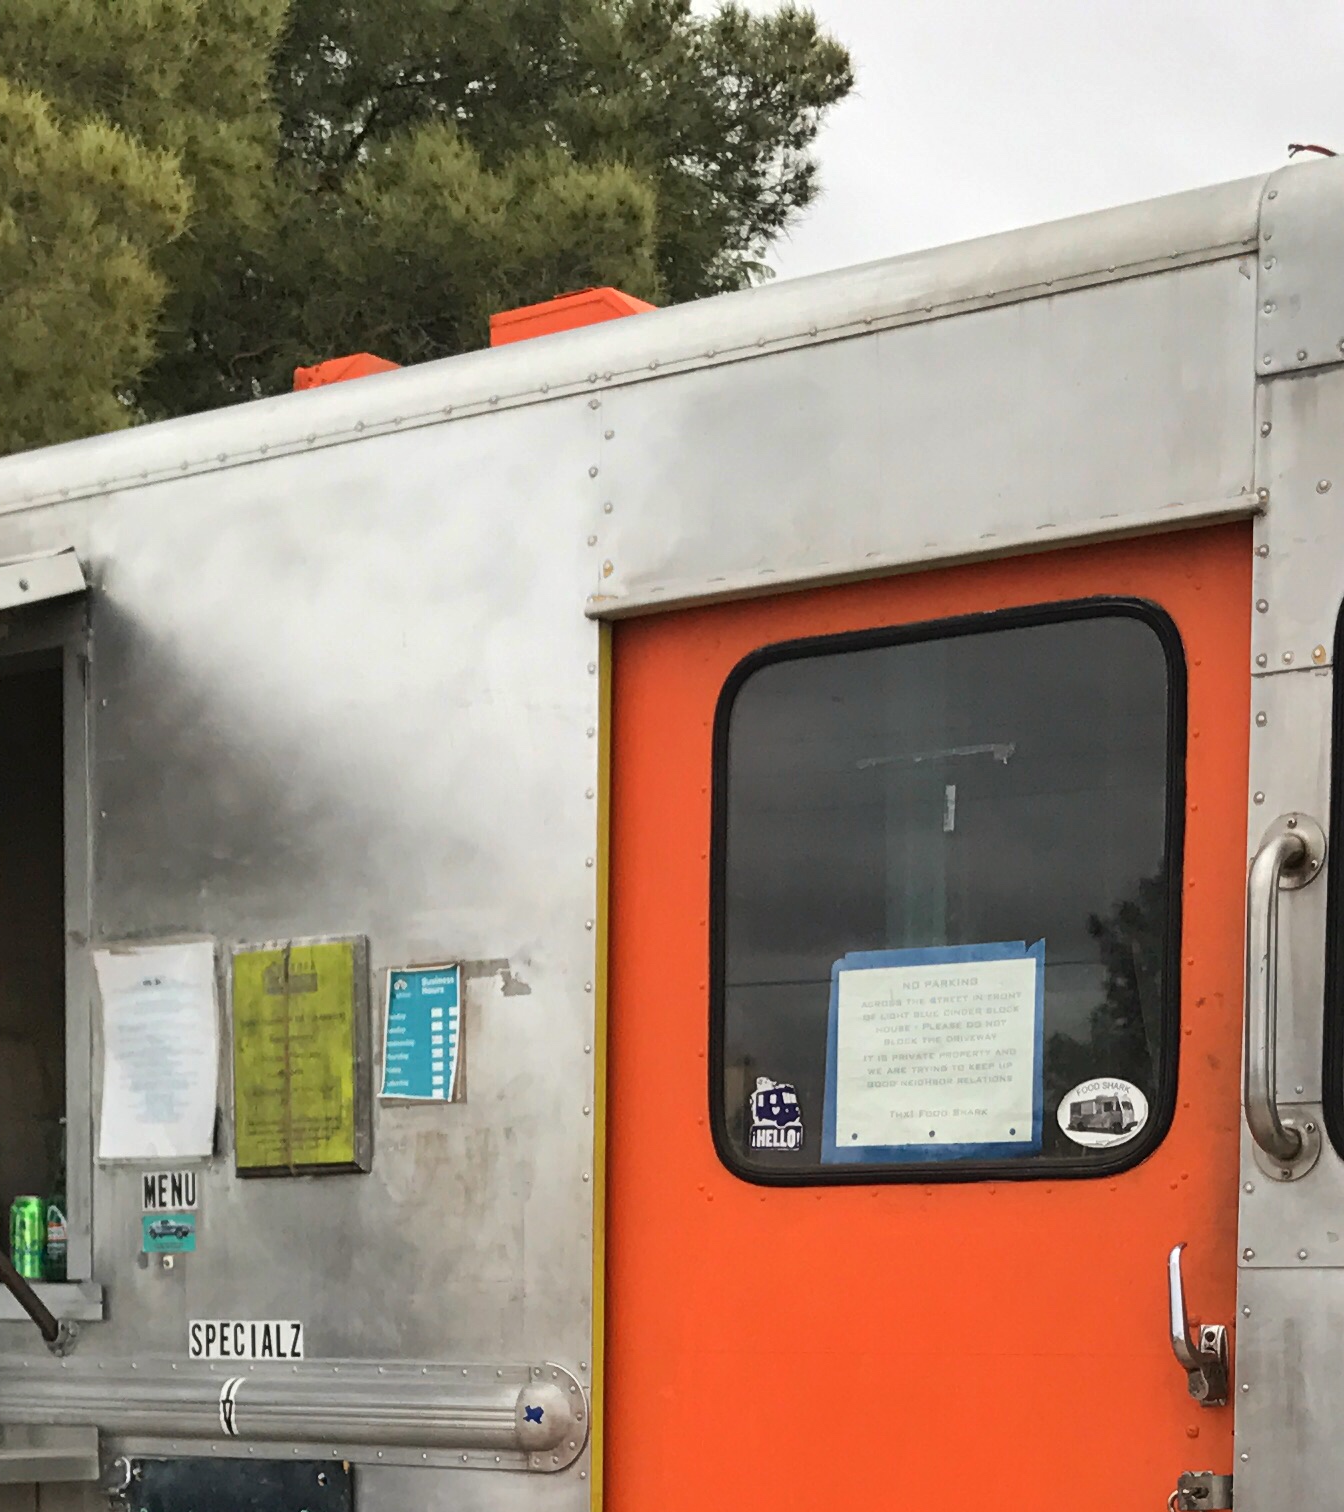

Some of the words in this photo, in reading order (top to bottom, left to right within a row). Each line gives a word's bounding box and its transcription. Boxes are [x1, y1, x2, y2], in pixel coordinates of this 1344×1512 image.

[903, 981, 919, 990] NO
[925, 977, 979, 988] PARKING
[1076, 1082, 1101, 1096] FOOD
[1102, 1081, 1131, 1094] SHARK
[143, 1172, 196, 1209] MENU
[191, 1322, 301, 1358] SPECIALZ
